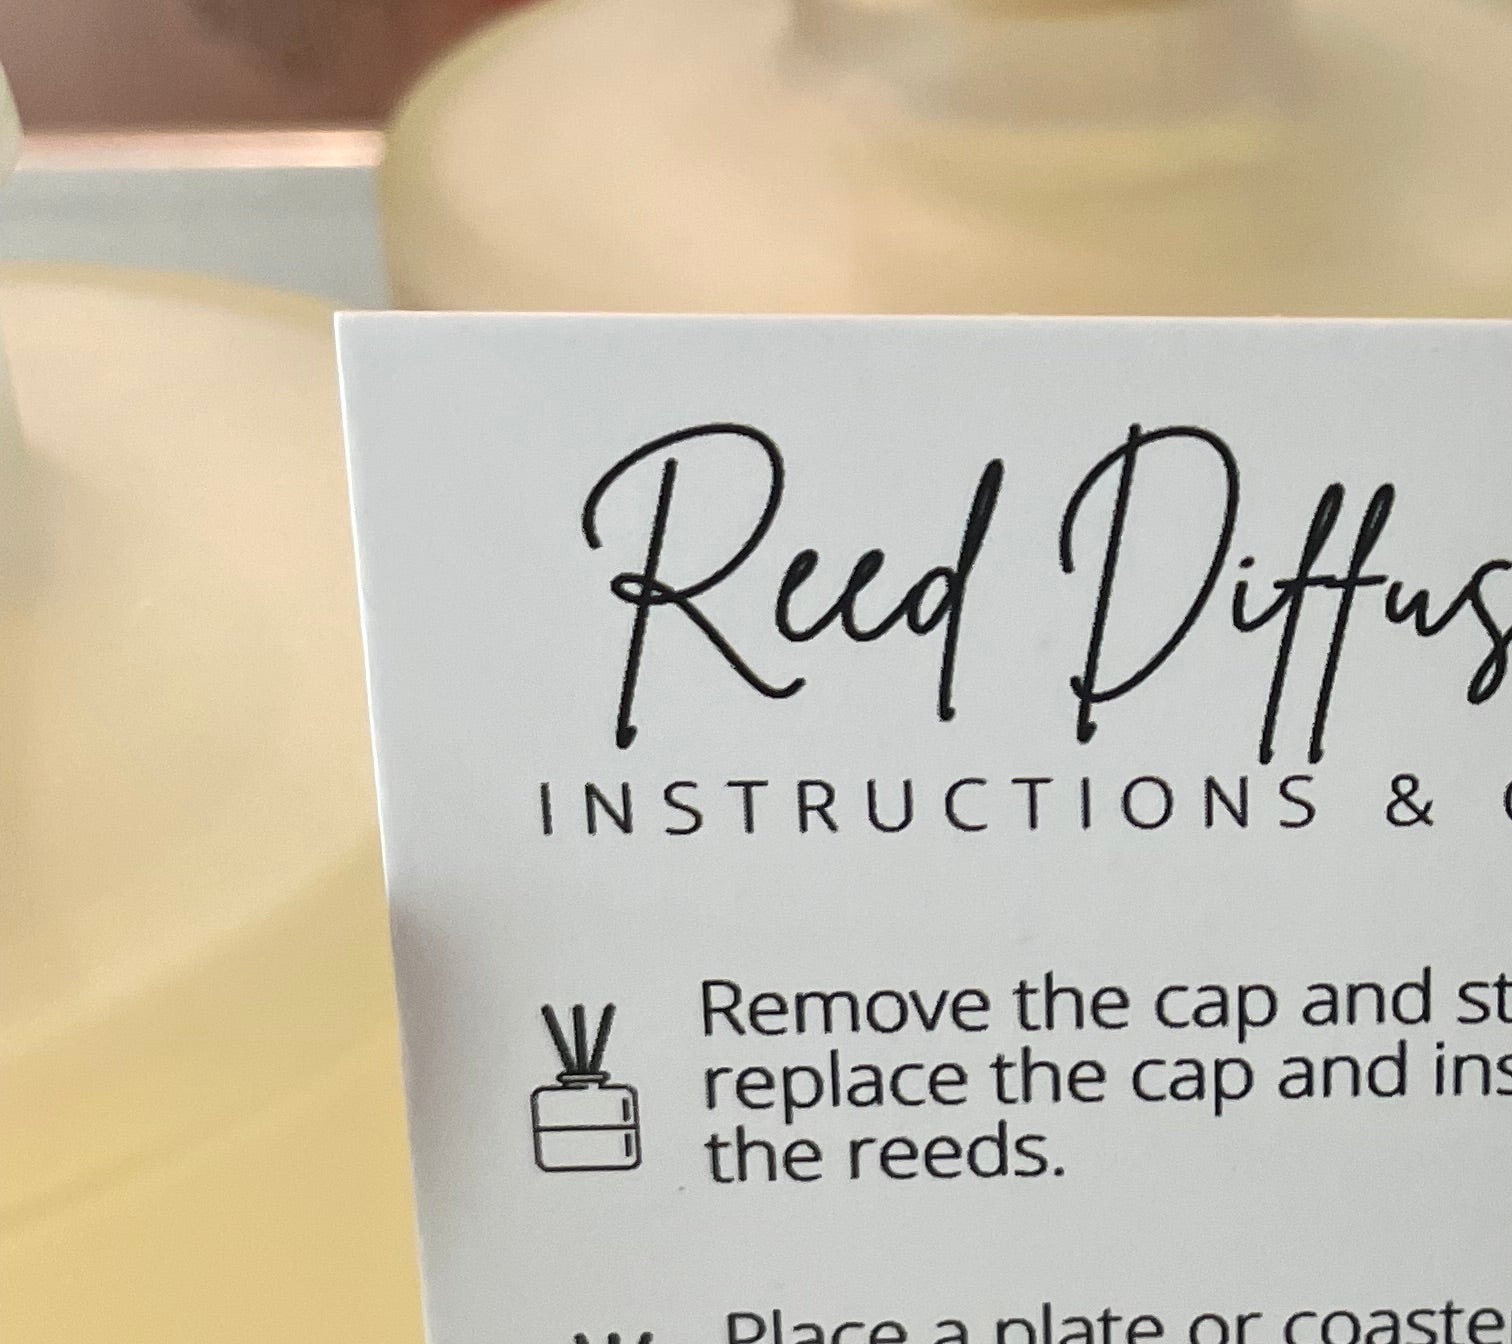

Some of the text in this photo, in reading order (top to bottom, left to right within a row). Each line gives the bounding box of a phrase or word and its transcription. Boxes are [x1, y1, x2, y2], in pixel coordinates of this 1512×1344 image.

[581, 422, 1005, 750] Reed
[540, 775, 1316, 836] INSTRUCTIONS
[1386, 773, 1434, 827] &
[702, 979, 990, 1037] Remove
[1012, 970, 1130, 1031] the
[1154, 984, 1278, 1044] cap
[1302, 965, 1431, 1027] and
[704, 1048, 968, 1126] replace
[989, 1045, 1107, 1105] the
[1132, 1058, 1254, 1117] cap
[1278, 1039, 1407, 1099] and
[704, 1119, 1064, 1184] the reeds.
